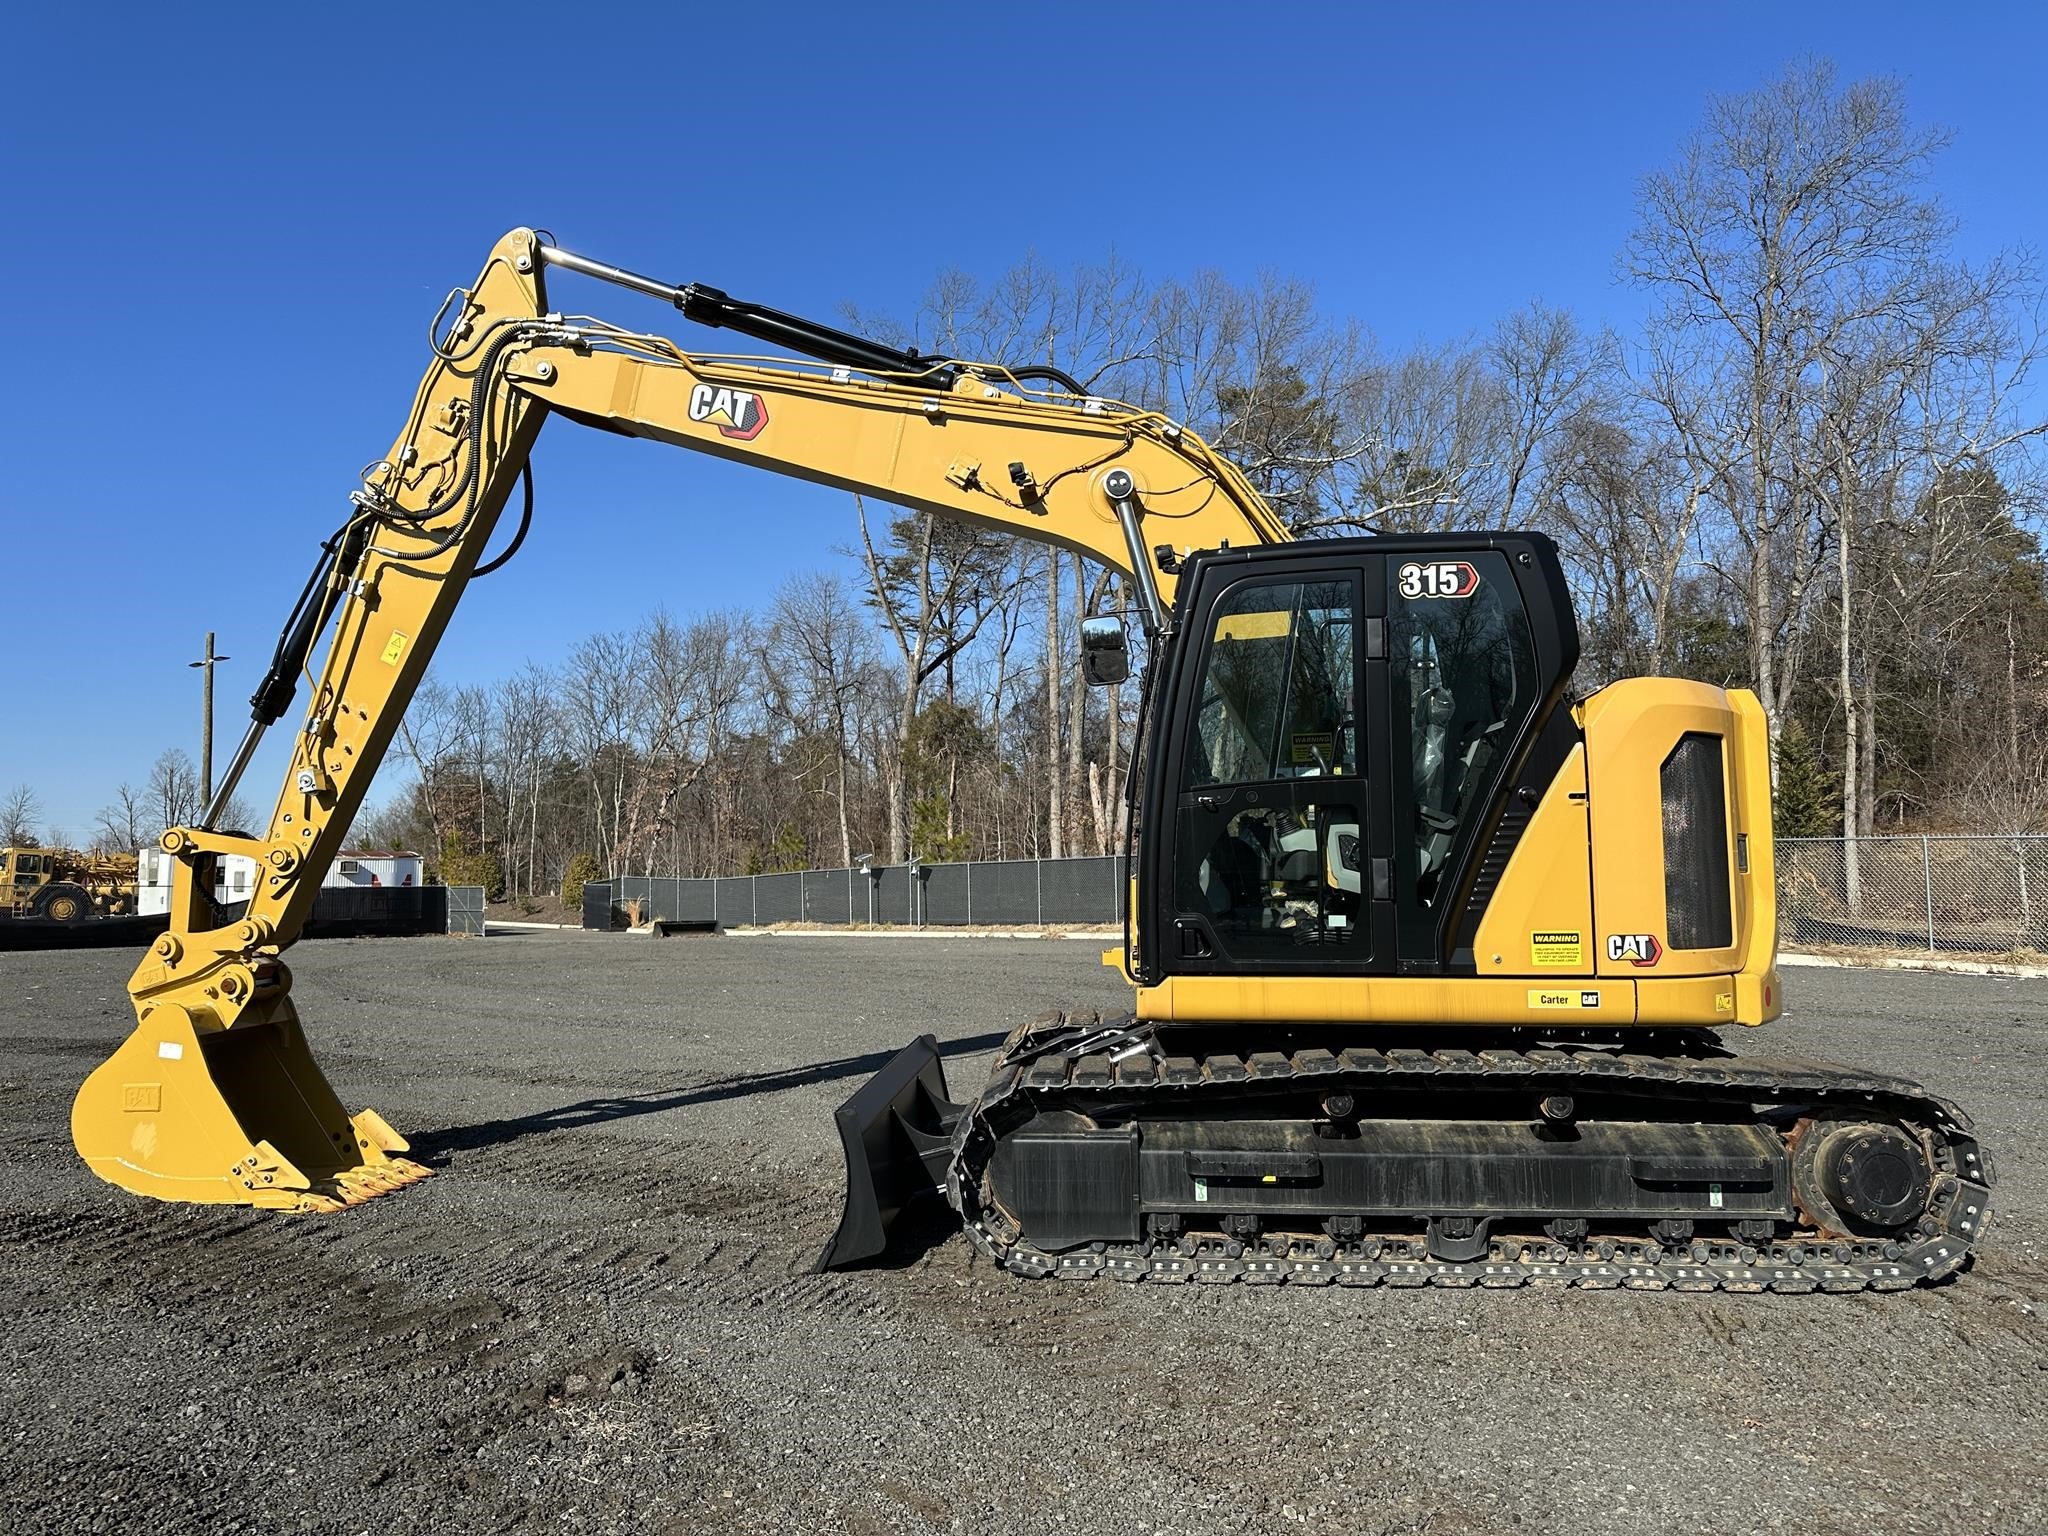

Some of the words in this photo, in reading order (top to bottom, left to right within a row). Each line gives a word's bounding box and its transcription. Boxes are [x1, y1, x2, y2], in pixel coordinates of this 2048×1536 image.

[689, 384, 753, 428] CAT
[1402, 564, 1459, 596] 315
[1534, 935, 1578, 943] WARNING
[1608, 935, 1649, 960] CAT
[1540, 994, 1569, 1004] Carter
[1582, 994, 1598, 1005] CAT
[124, 1087, 158, 1107] CAT
